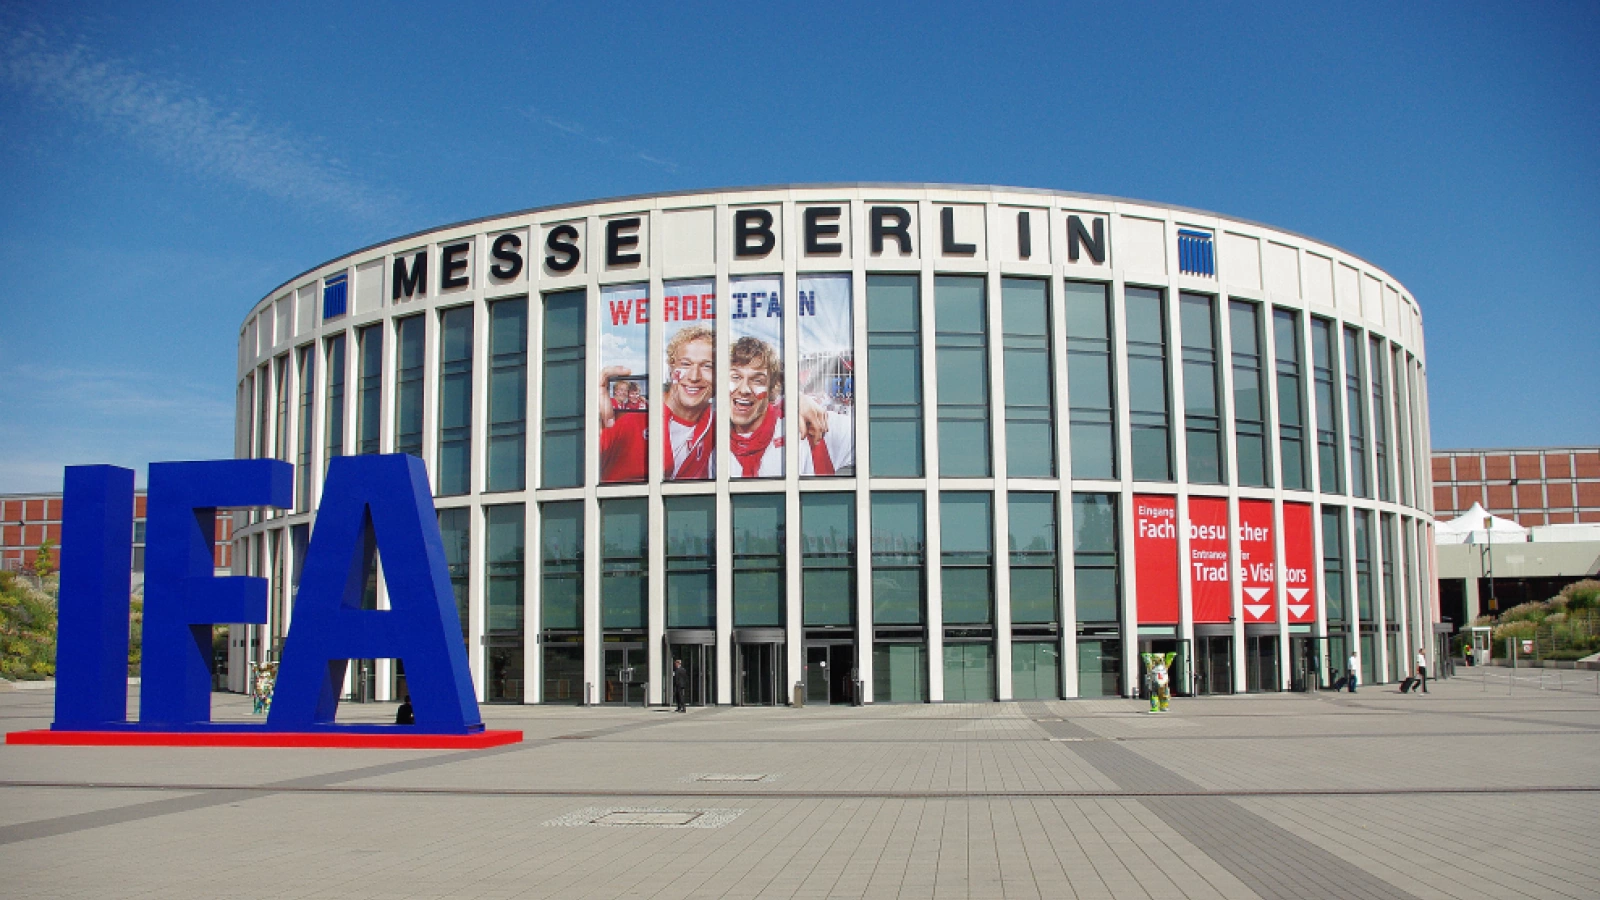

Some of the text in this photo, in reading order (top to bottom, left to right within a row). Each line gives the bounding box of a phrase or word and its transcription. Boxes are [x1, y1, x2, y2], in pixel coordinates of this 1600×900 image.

[392, 206, 1106, 300] MESSE BERLIN
[609, 294, 716, 326] WERDE
[1138, 505, 1175, 518] Eingang
[1192, 549, 1227, 560] Entrance
[54, 453, 480, 732] IFA
